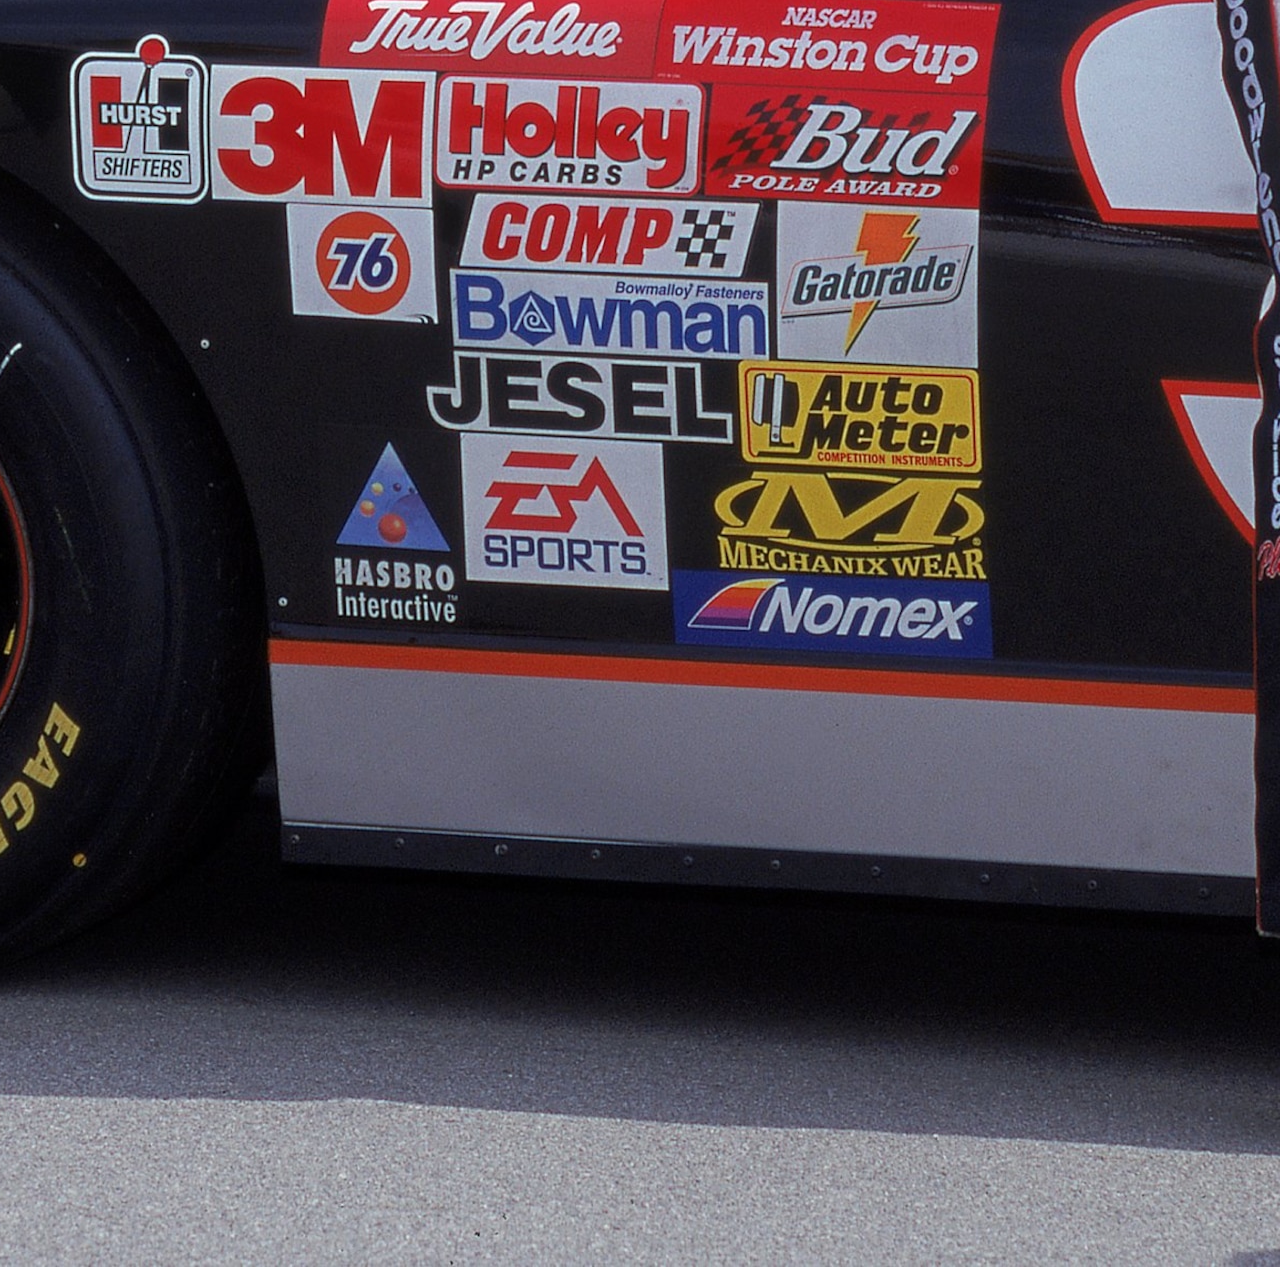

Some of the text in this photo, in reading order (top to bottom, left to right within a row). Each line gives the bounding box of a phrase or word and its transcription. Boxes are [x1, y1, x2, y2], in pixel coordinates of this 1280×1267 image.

[782, 6, 877, 30] NASCAR
[672, 25, 979, 84] Winston Cup
[100, 103, 182, 127] HURST
[448, 81, 690, 189] Holley
[218, 76, 426, 199] 3M
[769, 103, 977, 177] Bud
[102, 157, 183, 180] SHIFTERS
[452, 159, 623, 186] HP CARBS
[728, 173, 942, 199] POLE AWARD
[482, 200, 673, 266] COMP
[327, 232, 399, 290] 76
[615, 281, 765, 301] Bowmalloy Fasteners
[792, 259, 957, 307] Gatorade
[426, 349, 734, 444] JESEL
[810, 373, 944, 415] Auto
[803, 413, 970, 455] Meter
[817, 451, 964, 468] COMPETITION INSTRUMENTS
[484, 450, 645, 537] EA
[334, 557, 455, 593] HASBRO
[484, 534, 647, 576] SPORTS
[717, 535, 987, 580] MECHANIX WEAR
[336, 588, 457, 623] Interactive
[759, 587, 978, 641] Nomex
